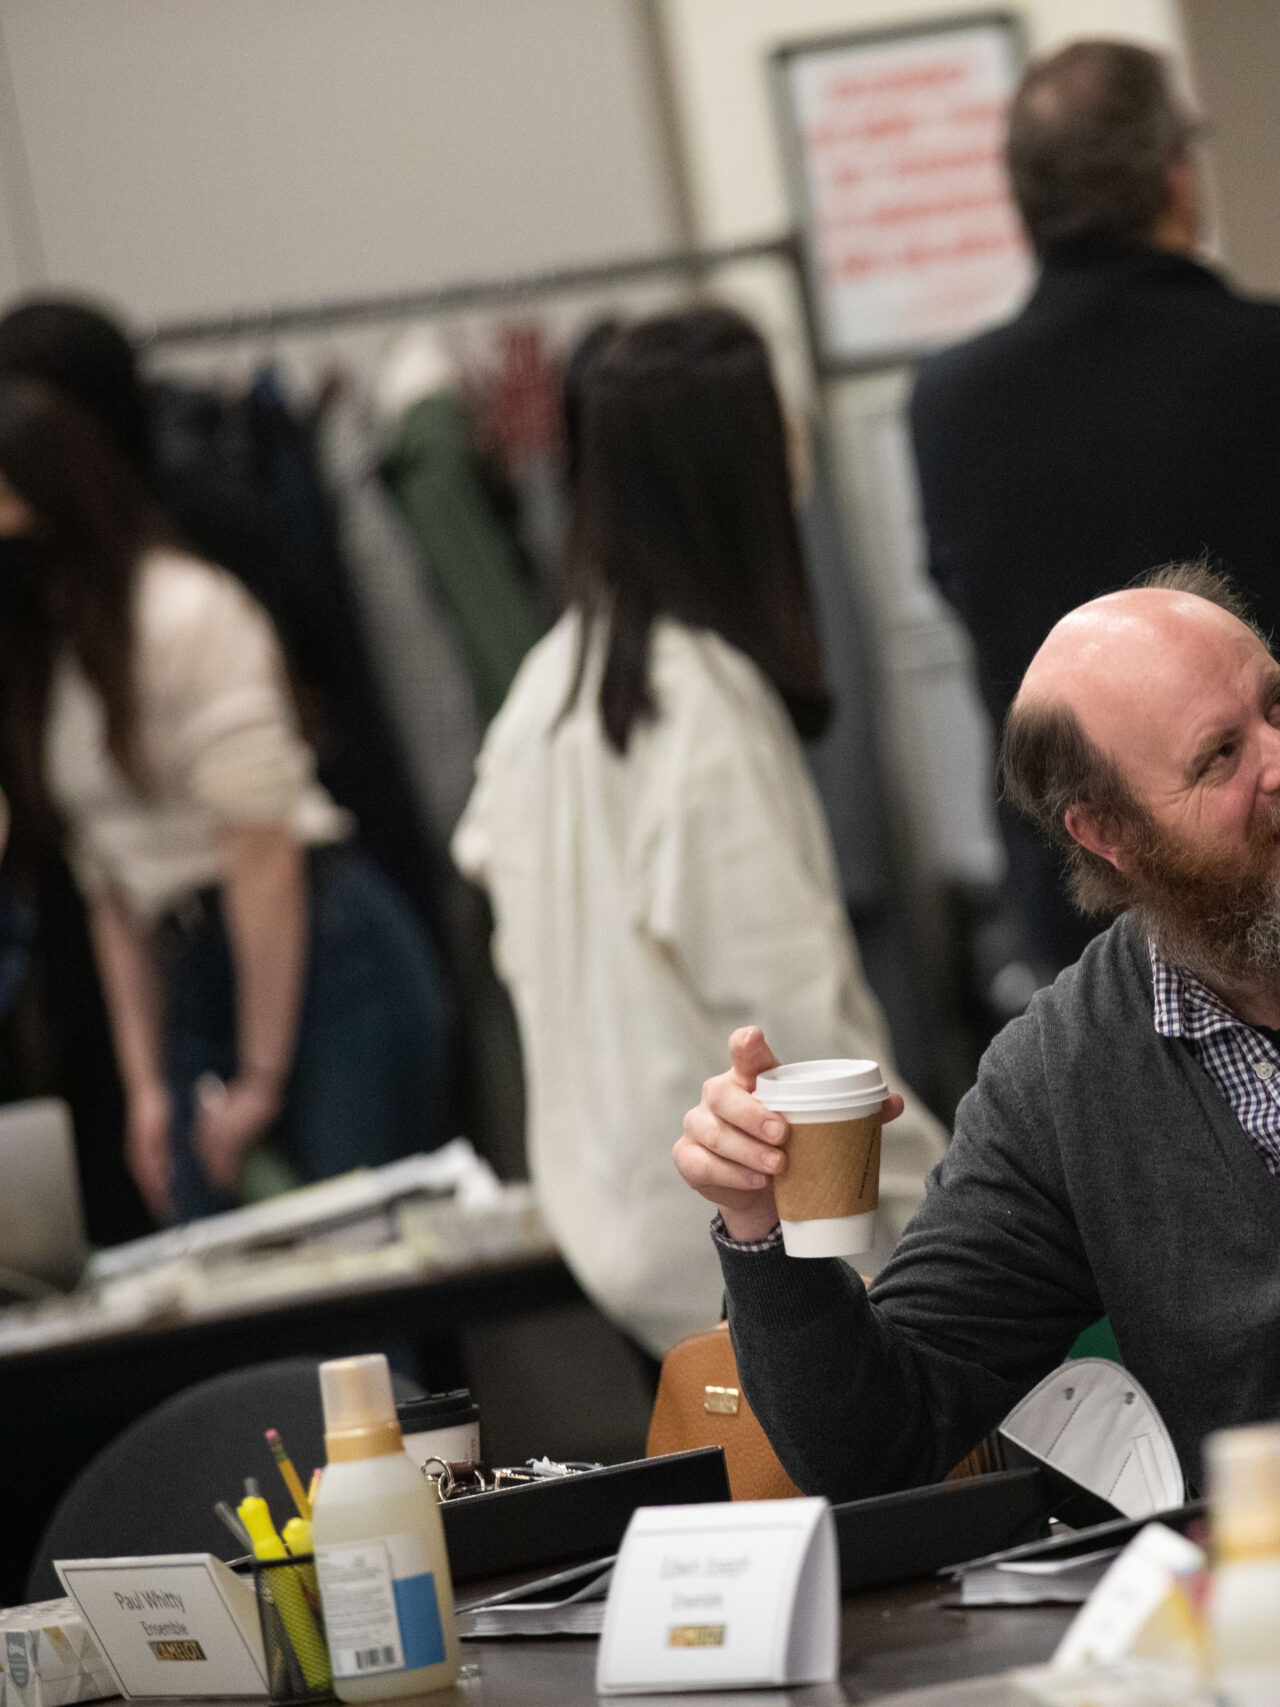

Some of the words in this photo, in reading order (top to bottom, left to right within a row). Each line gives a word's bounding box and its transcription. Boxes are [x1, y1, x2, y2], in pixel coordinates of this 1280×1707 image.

[114, 1591, 144, 1610] Paul
[141, 1590, 186, 1613] Whitty
[141, 1620, 189, 1636] Ensemble
